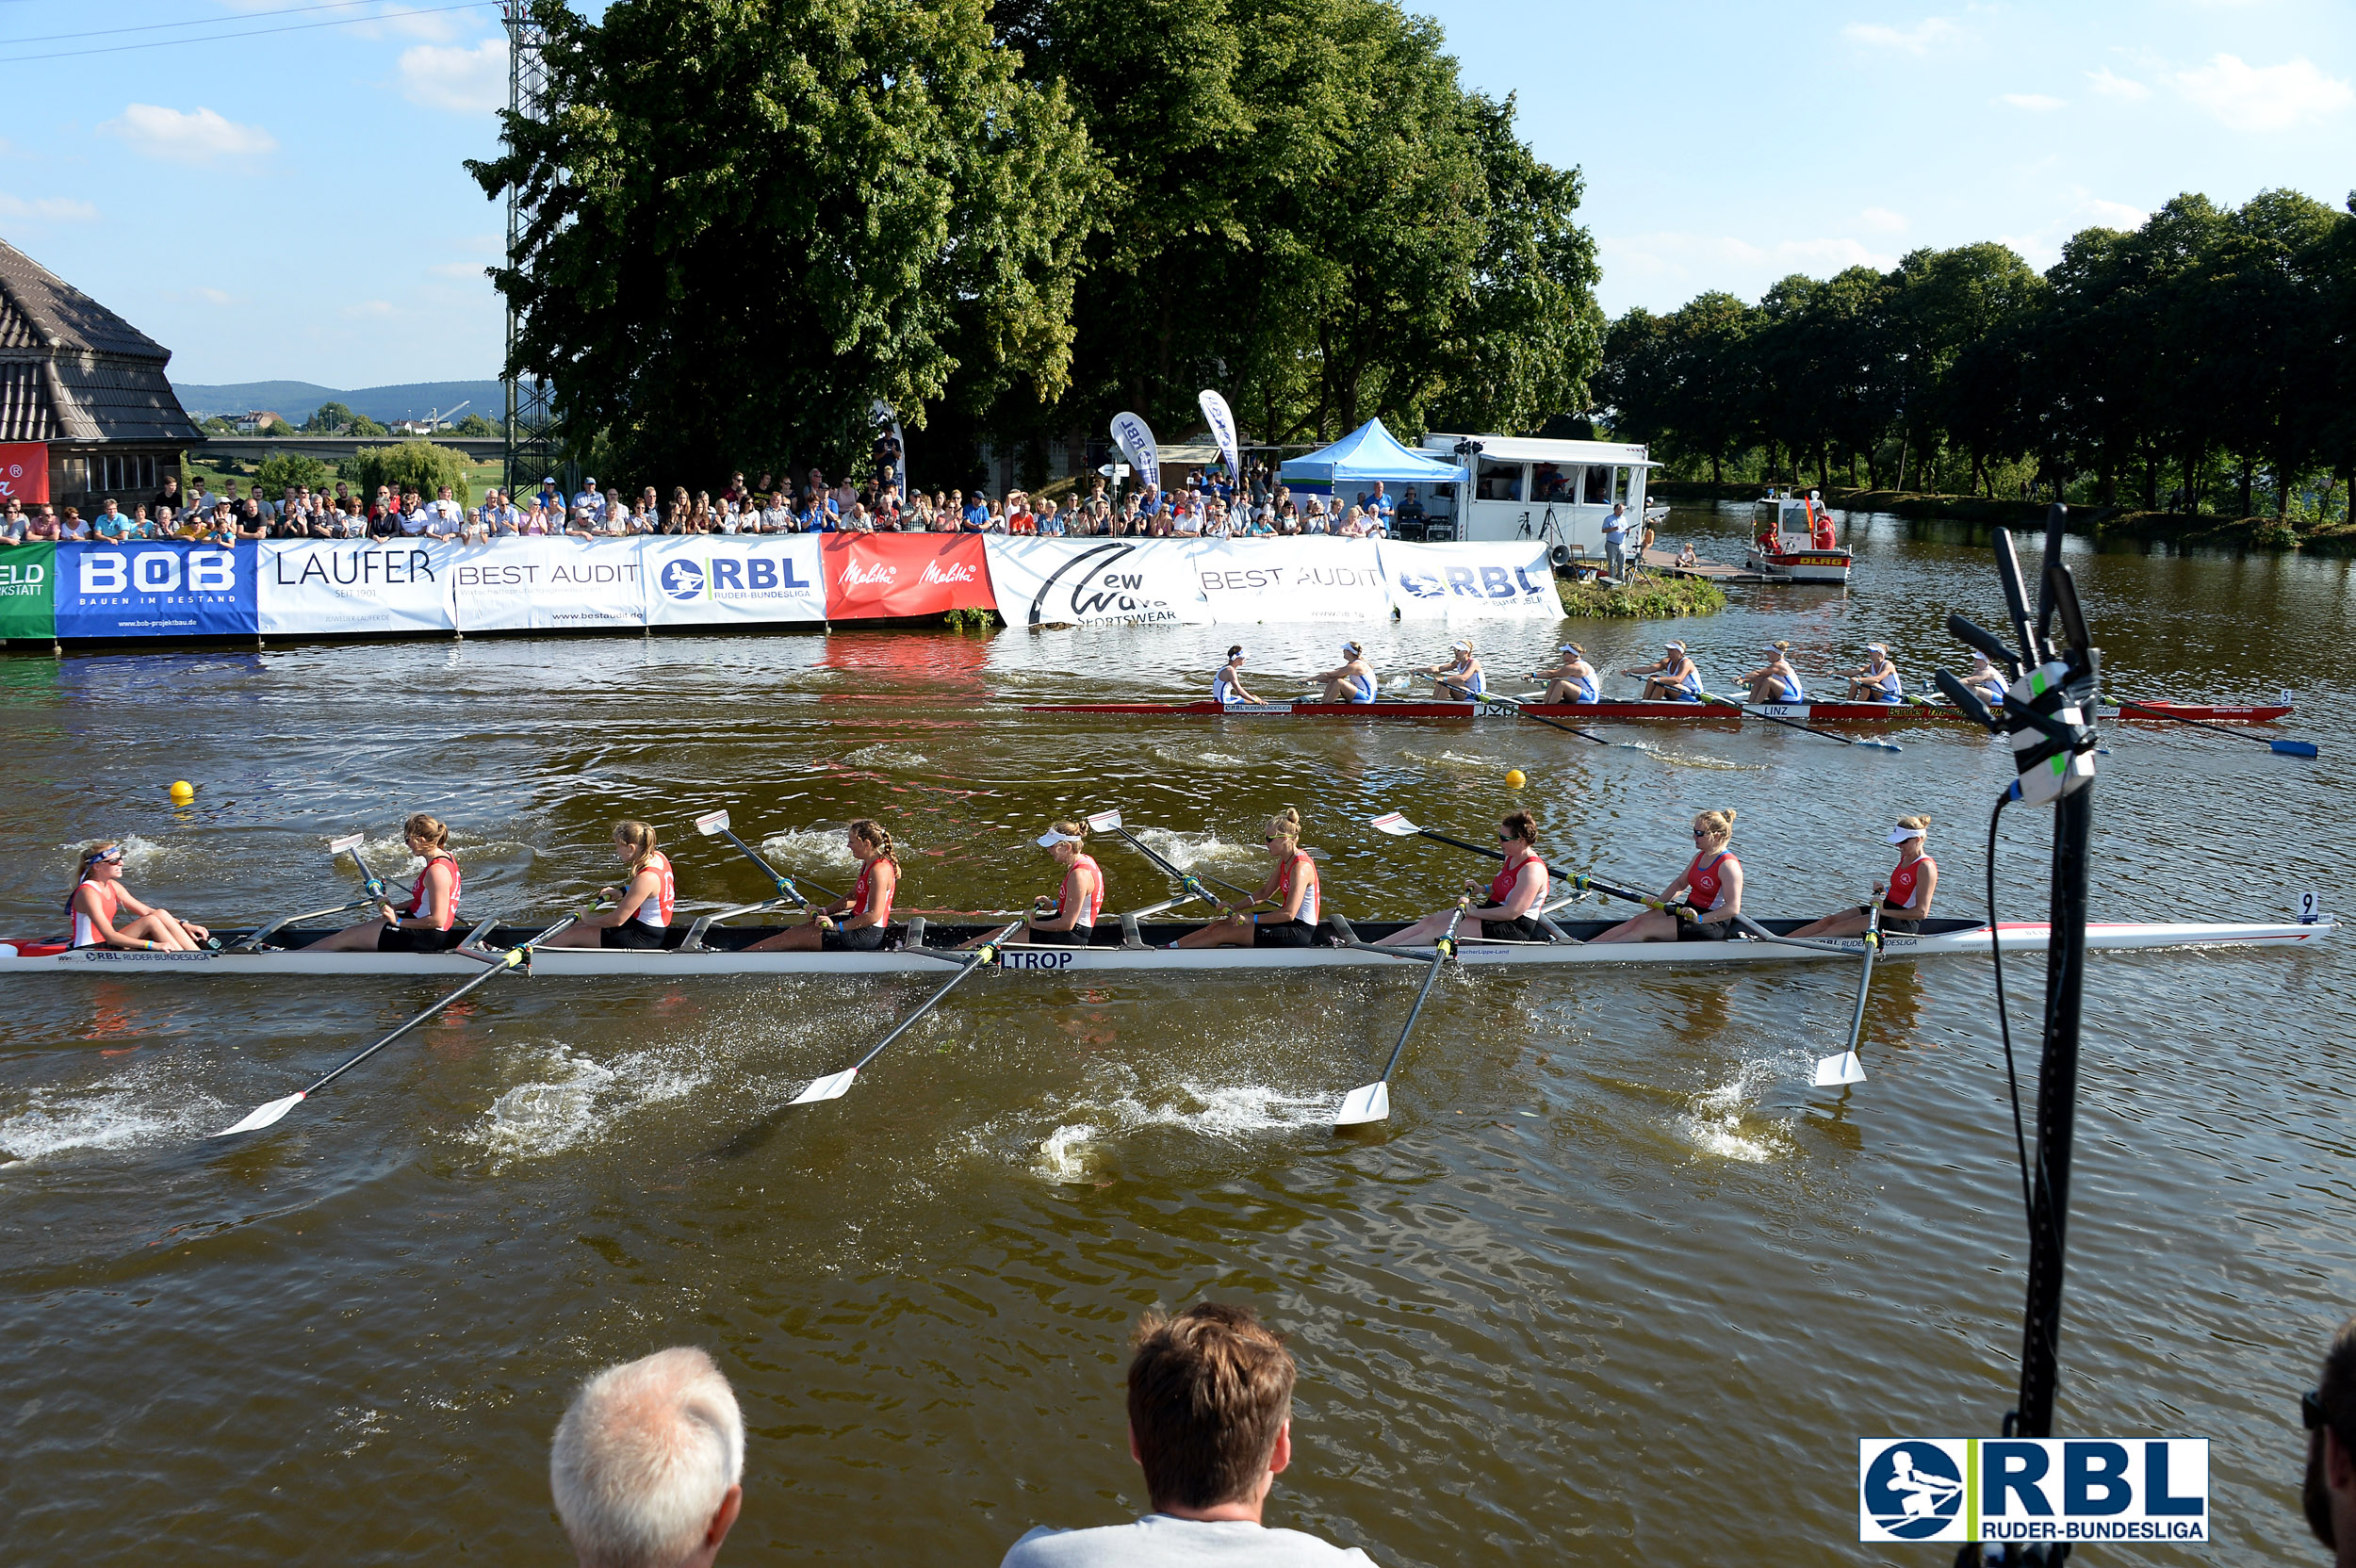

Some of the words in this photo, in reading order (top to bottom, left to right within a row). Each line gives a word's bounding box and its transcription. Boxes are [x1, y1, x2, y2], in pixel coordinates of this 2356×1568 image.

[277, 549, 435, 584] LAUFER
[1799, 557, 1843, 566] DLRG
[79, 551, 236, 594] BOB
[459, 565, 540, 585] BEST
[551, 564, 639, 583] AUDIT
[712, 558, 810, 590] RBL
[1201, 567, 1284, 590] BEST
[1297, 567, 1379, 586] AUDIT
[1444, 565, 1546, 598] RBL
[335, 589, 354, 598] SEIT
[356, 589, 376, 598] 1901
[713, 590, 811, 599] RUDER-BUNDESLIGA
[79, 596, 129, 606] BAUEN
[140, 596, 156, 605] IM
[167, 596, 236, 604] BESTAND
[118, 619, 197, 629] www.bob-projektbau.de
[2282, 691, 2289, 702] 5
[1764, 706, 1789, 716] LINZ
[1888, 707, 1924, 716] Banner
[2302, 893, 2313, 915] 9
[97, 952, 122, 960] RBL
